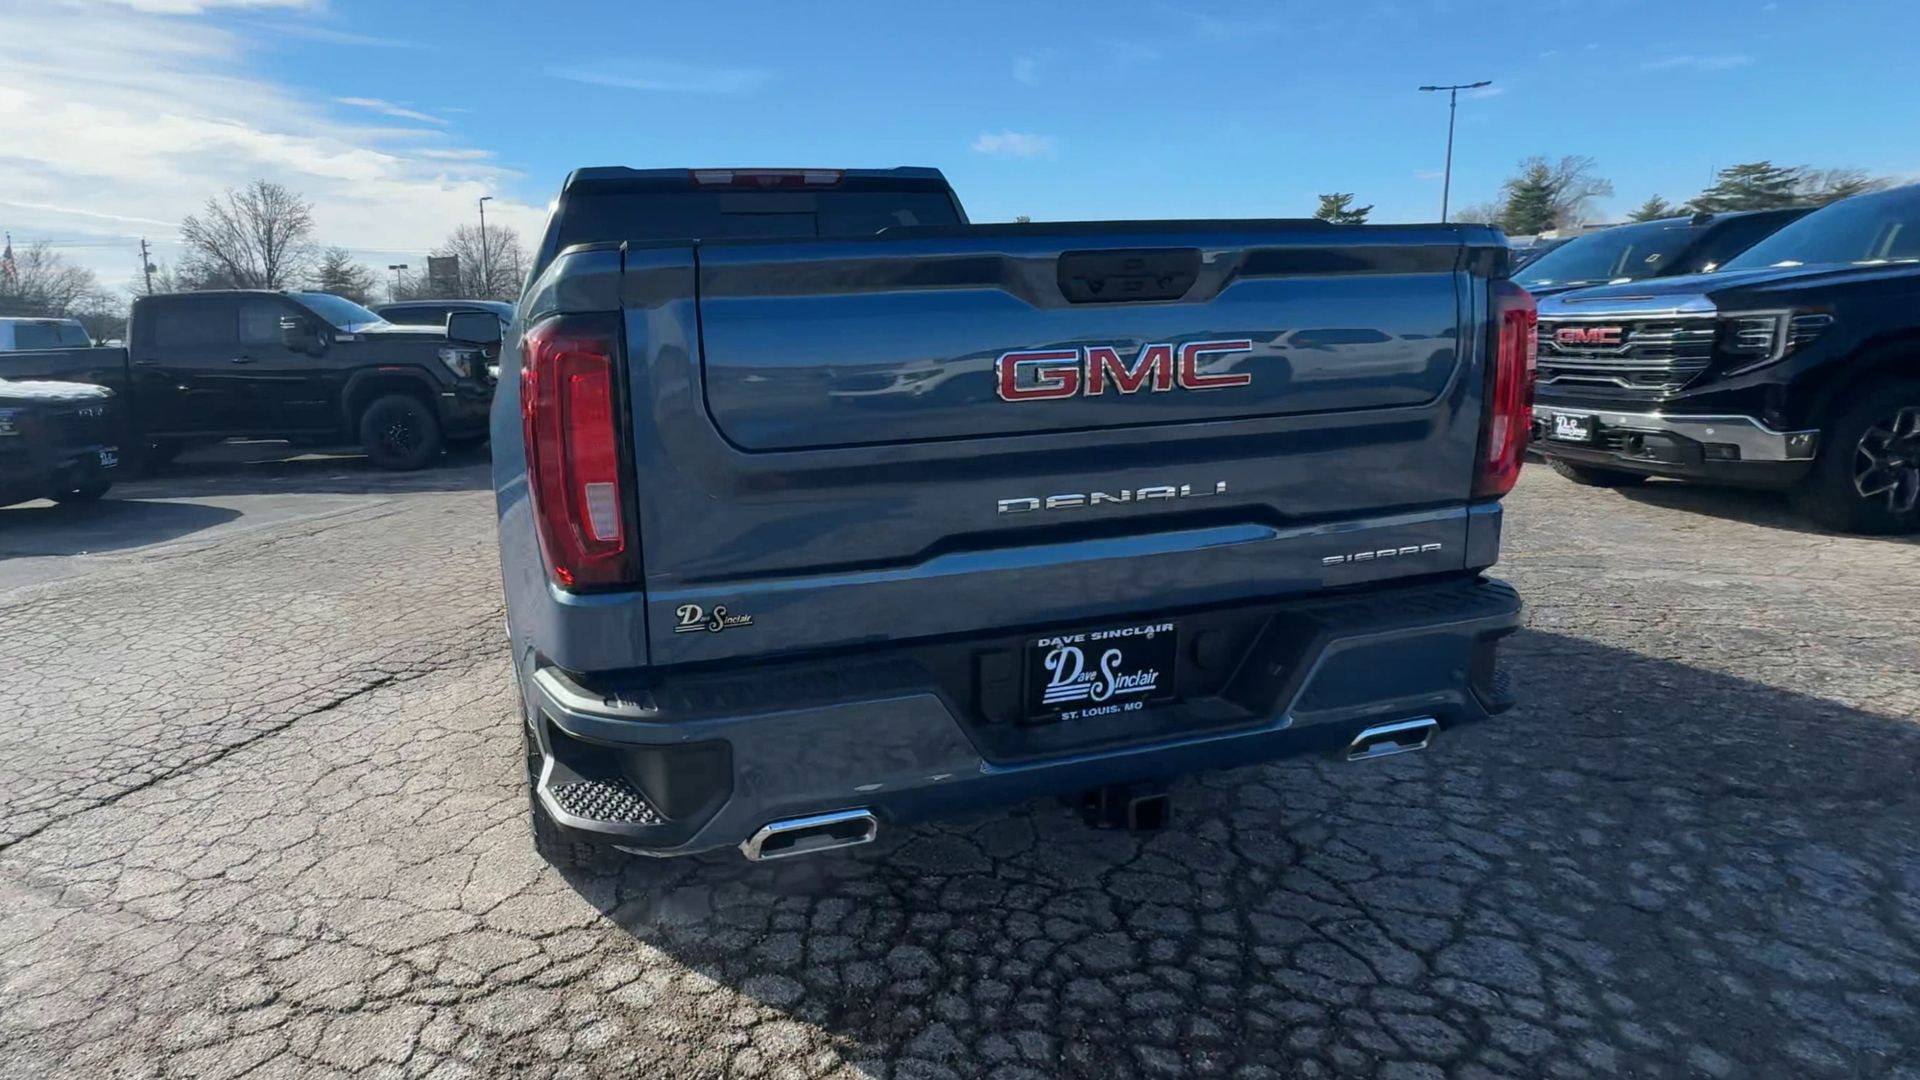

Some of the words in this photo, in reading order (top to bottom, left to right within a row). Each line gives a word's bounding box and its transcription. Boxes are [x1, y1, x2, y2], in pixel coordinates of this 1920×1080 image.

[1555, 327, 1622, 344] GMC
[995, 338, 1252, 402] GMC
[997, 480, 1227, 515] DENALI
[1321, 543, 1442, 567] SIERRA
[709, 605, 752, 632] Sinclair
[1038, 634, 1086, 648] DAVE
[1091, 623, 1174, 640] SINCLAIR
[1044, 646, 1097, 687] Dave
[1090, 648, 1159, 701] Sinclair
[1061, 711, 1079, 721] ST.
[1124, 701, 1143, 711] MO
